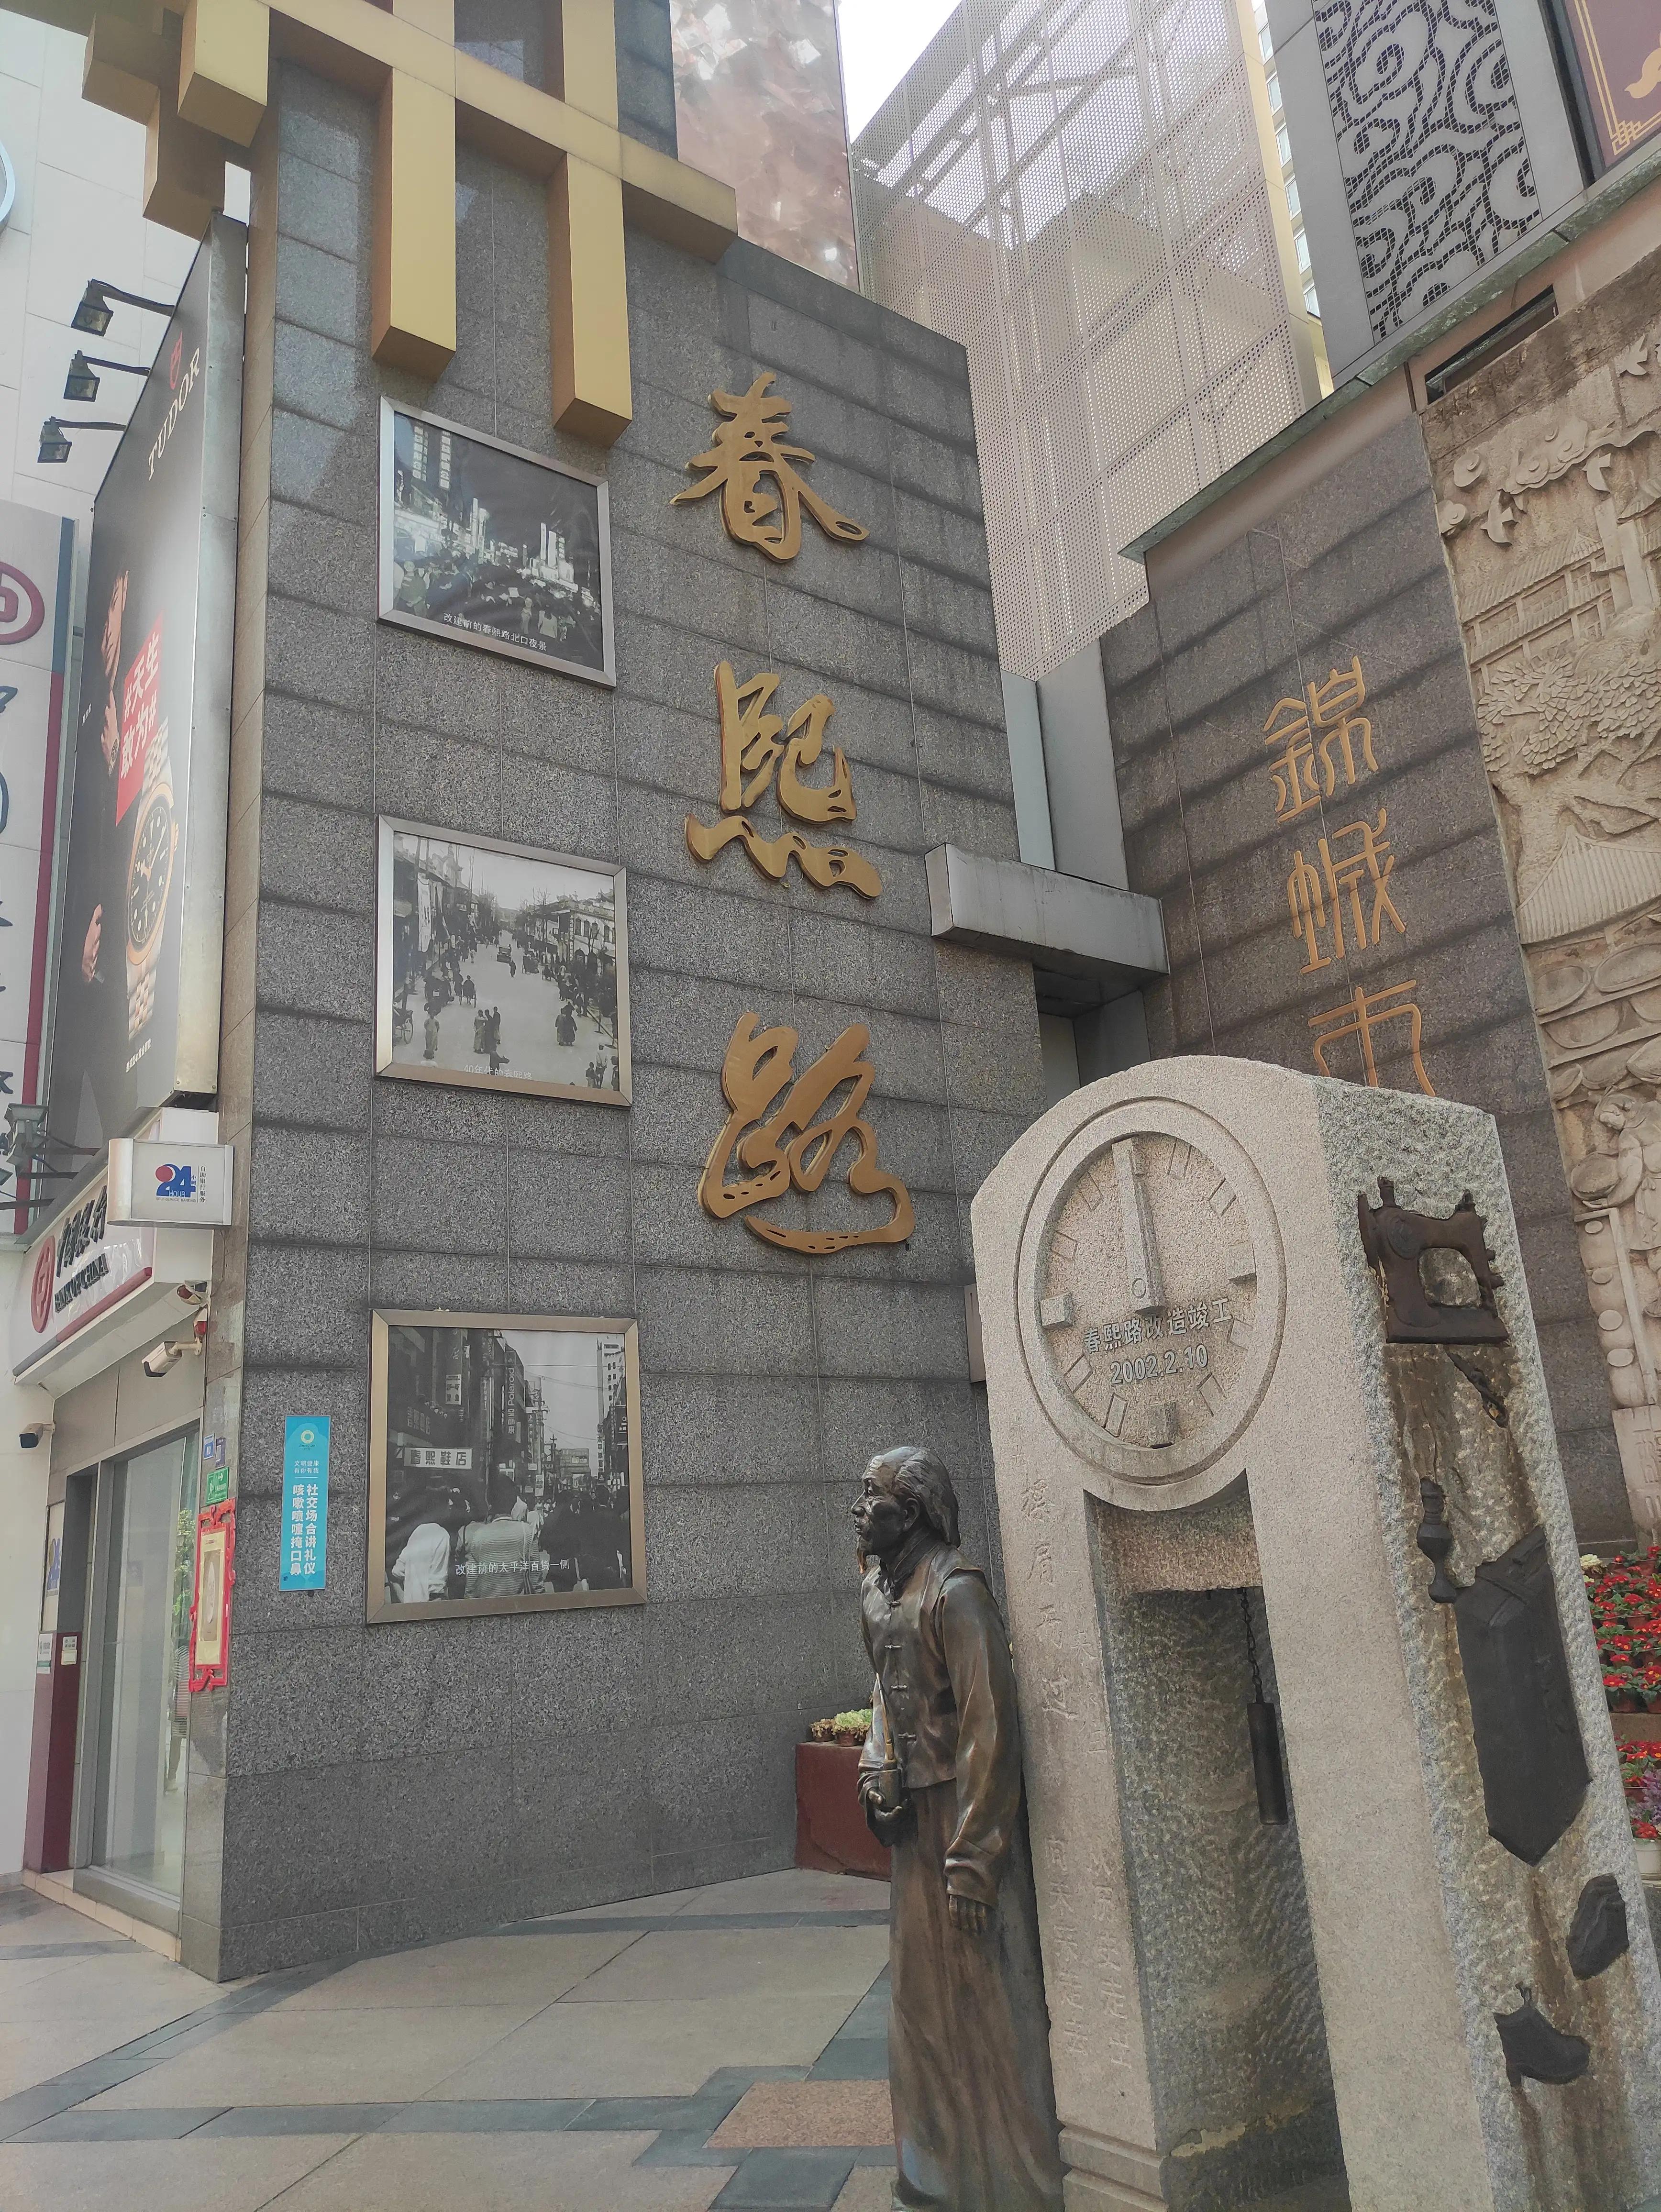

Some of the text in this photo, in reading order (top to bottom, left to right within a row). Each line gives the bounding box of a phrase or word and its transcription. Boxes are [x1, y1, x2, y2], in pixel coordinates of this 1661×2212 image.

[148, 346, 200, 481] TUDOR
[443, 613, 547, 651] 改建前的春熙路北口夜景
[124, 631, 159, 723] #天生
[121, 689, 157, 779] 敢为#
[670, 372, 916, 1255] 春熙路
[155, 1163, 196, 1198] 24
[81, 1252, 109, 1290] CHINA
[1084, 1297, 1233, 1355] 春熙路改造竣工
[1110, 1344, 1210, 1385] 2002.2.10
[410, 1449, 467, 1466] 春熙鞋店
[290, 1484, 305, 1575] 咳嗽喷嚏掩口鼻
[303, 1483, 319, 1575] 社交场合讲礼仪
[455, 1559, 570, 1576] 改建前的太平洋百货一侧
